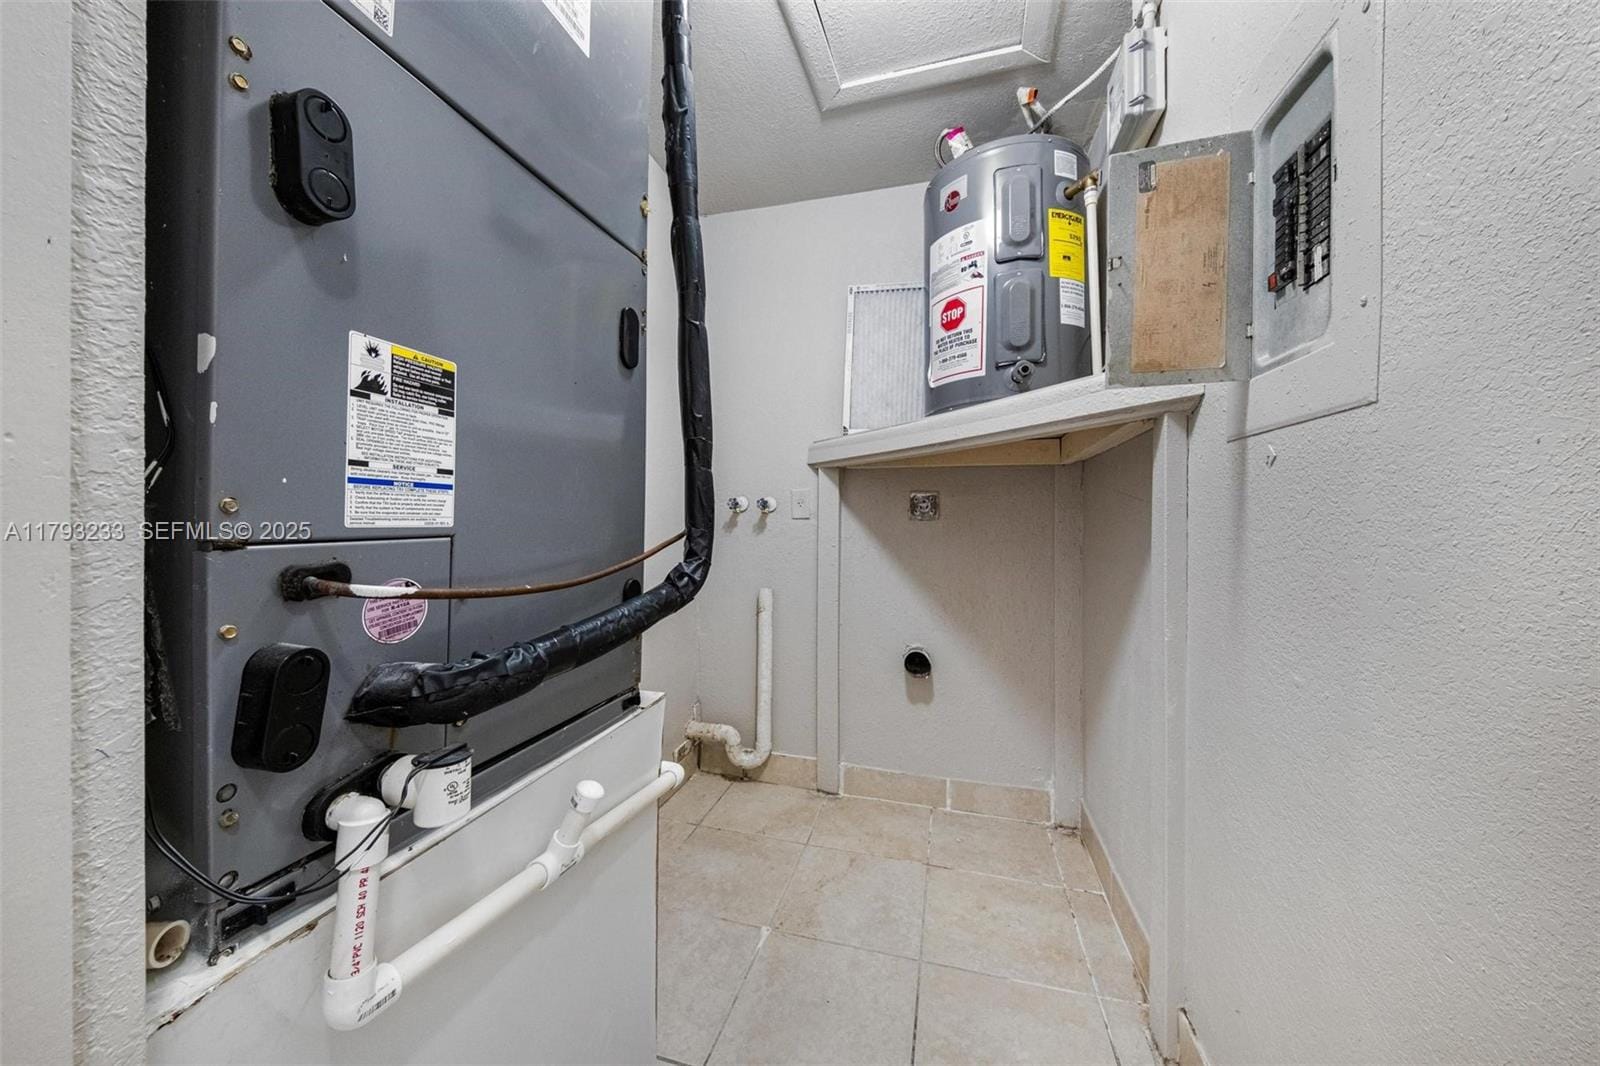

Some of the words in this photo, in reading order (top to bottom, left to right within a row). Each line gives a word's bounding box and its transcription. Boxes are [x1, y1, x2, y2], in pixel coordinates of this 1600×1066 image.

[942, 306, 964, 324] STOP
[947, 331, 962, 340] RETURN
[948, 336, 963, 344] HEATER
[955, 338, 977, 348] PURCHASE
[421, 356, 443, 367] CAUTION
[385, 398, 424, 410] INSTALLATION
[358, 890, 367, 900] 40
[356, 904, 366, 919] SCH
[354, 921, 365, 940] 1120
